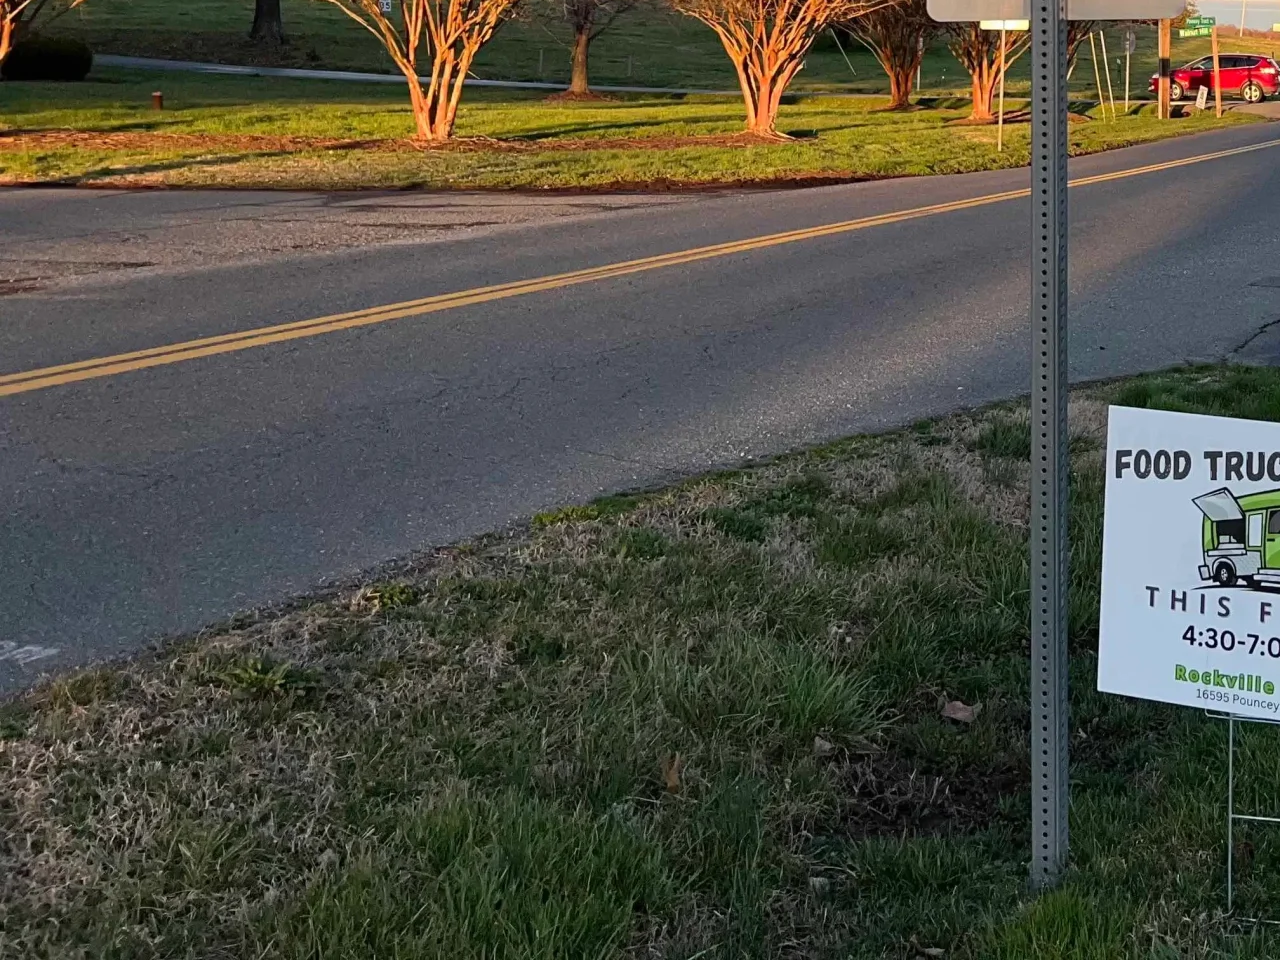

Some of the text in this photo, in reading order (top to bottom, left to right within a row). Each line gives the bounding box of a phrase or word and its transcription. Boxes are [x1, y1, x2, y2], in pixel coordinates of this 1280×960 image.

[1115, 449, 1192, 480] FOOD
[1145, 585, 1232, 617] THIS
[1175, 664, 1275, 695] Rockville
[1196, 688, 1230, 704] 16595
[1232, 693, 1280, 713] Pouncey
